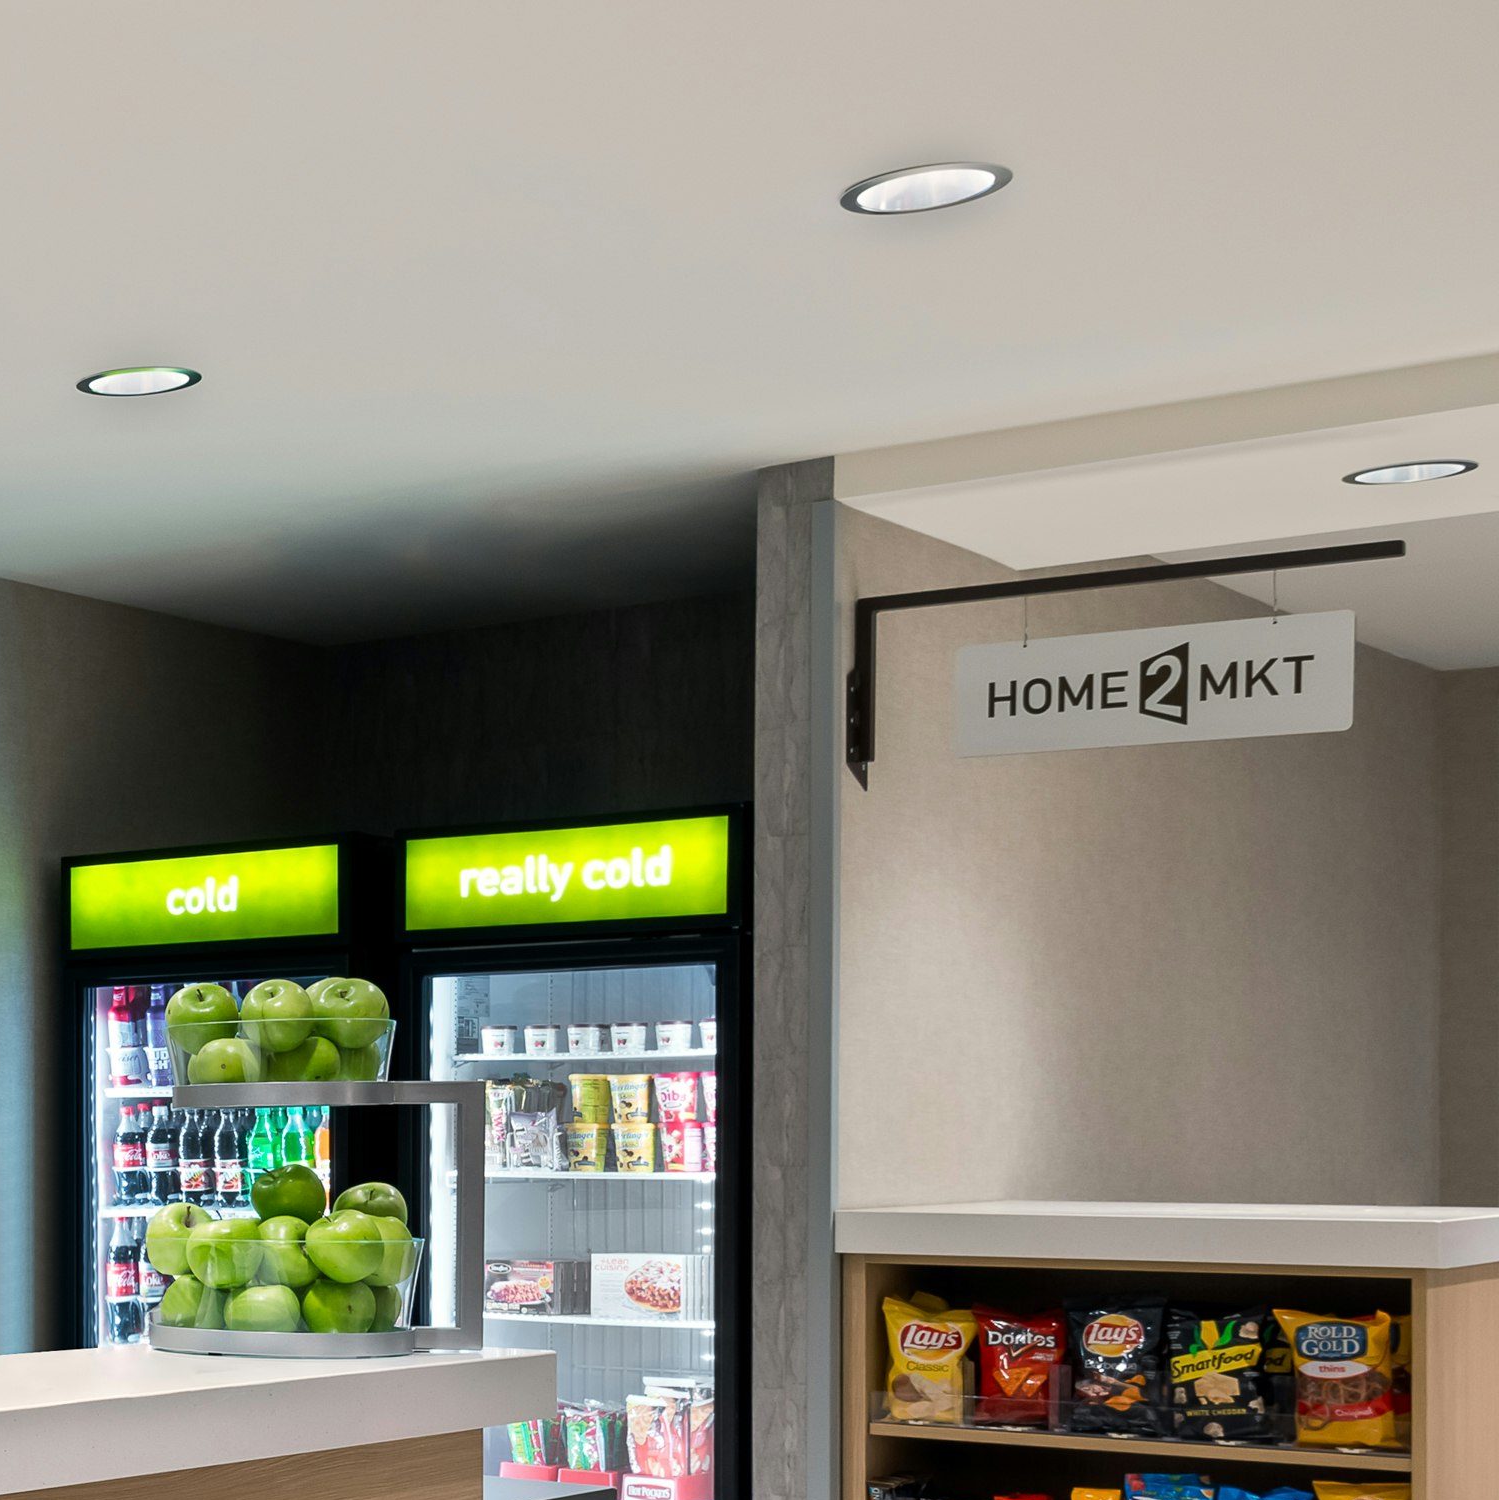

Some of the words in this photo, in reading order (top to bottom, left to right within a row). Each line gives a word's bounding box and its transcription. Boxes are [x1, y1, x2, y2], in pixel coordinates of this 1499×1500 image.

[1199, 654, 1315, 702] MKT
[459, 853, 575, 903] really
[581, 843, 673, 890] cold
[166, 875, 239, 916] cold
[1307, 1325, 1357, 1340] ROLD
[1301, 1338, 1360, 1356] GOLD
[906, 1360, 950, 1373] Classic
[1171, 1349, 1255, 1379] Smartfood
[1318, 1364, 1346, 1374] thins
